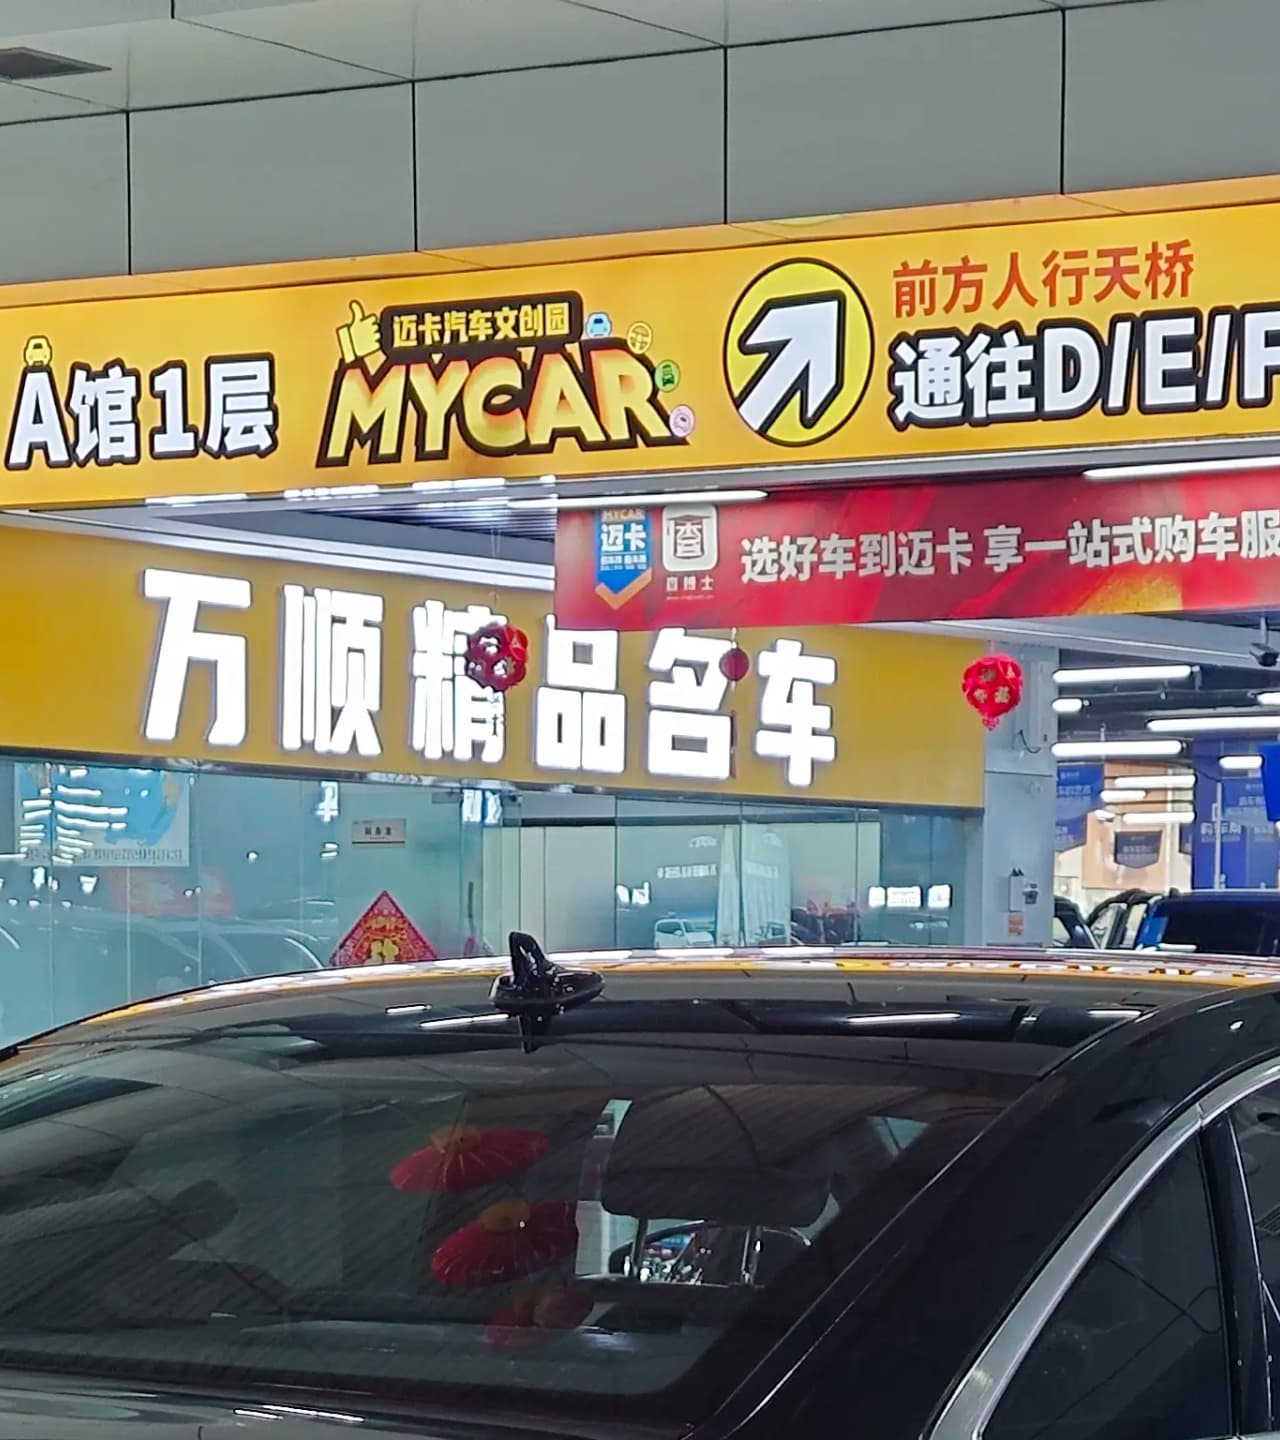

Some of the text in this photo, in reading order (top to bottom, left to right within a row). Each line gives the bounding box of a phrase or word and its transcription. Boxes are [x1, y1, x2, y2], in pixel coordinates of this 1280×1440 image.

[892, 239, 1195, 317] 前方人行天桥
[391, 300, 573, 348] 迈卡汽车文创园
[7, 360, 276, 467] A馆1层
[322, 344, 680, 466] MYCAR
[600, 522, 647, 552] 迈卡
[740, 526, 972, 584] 选好车到迈卡
[141, 567, 839, 787] 万顺精品名车
